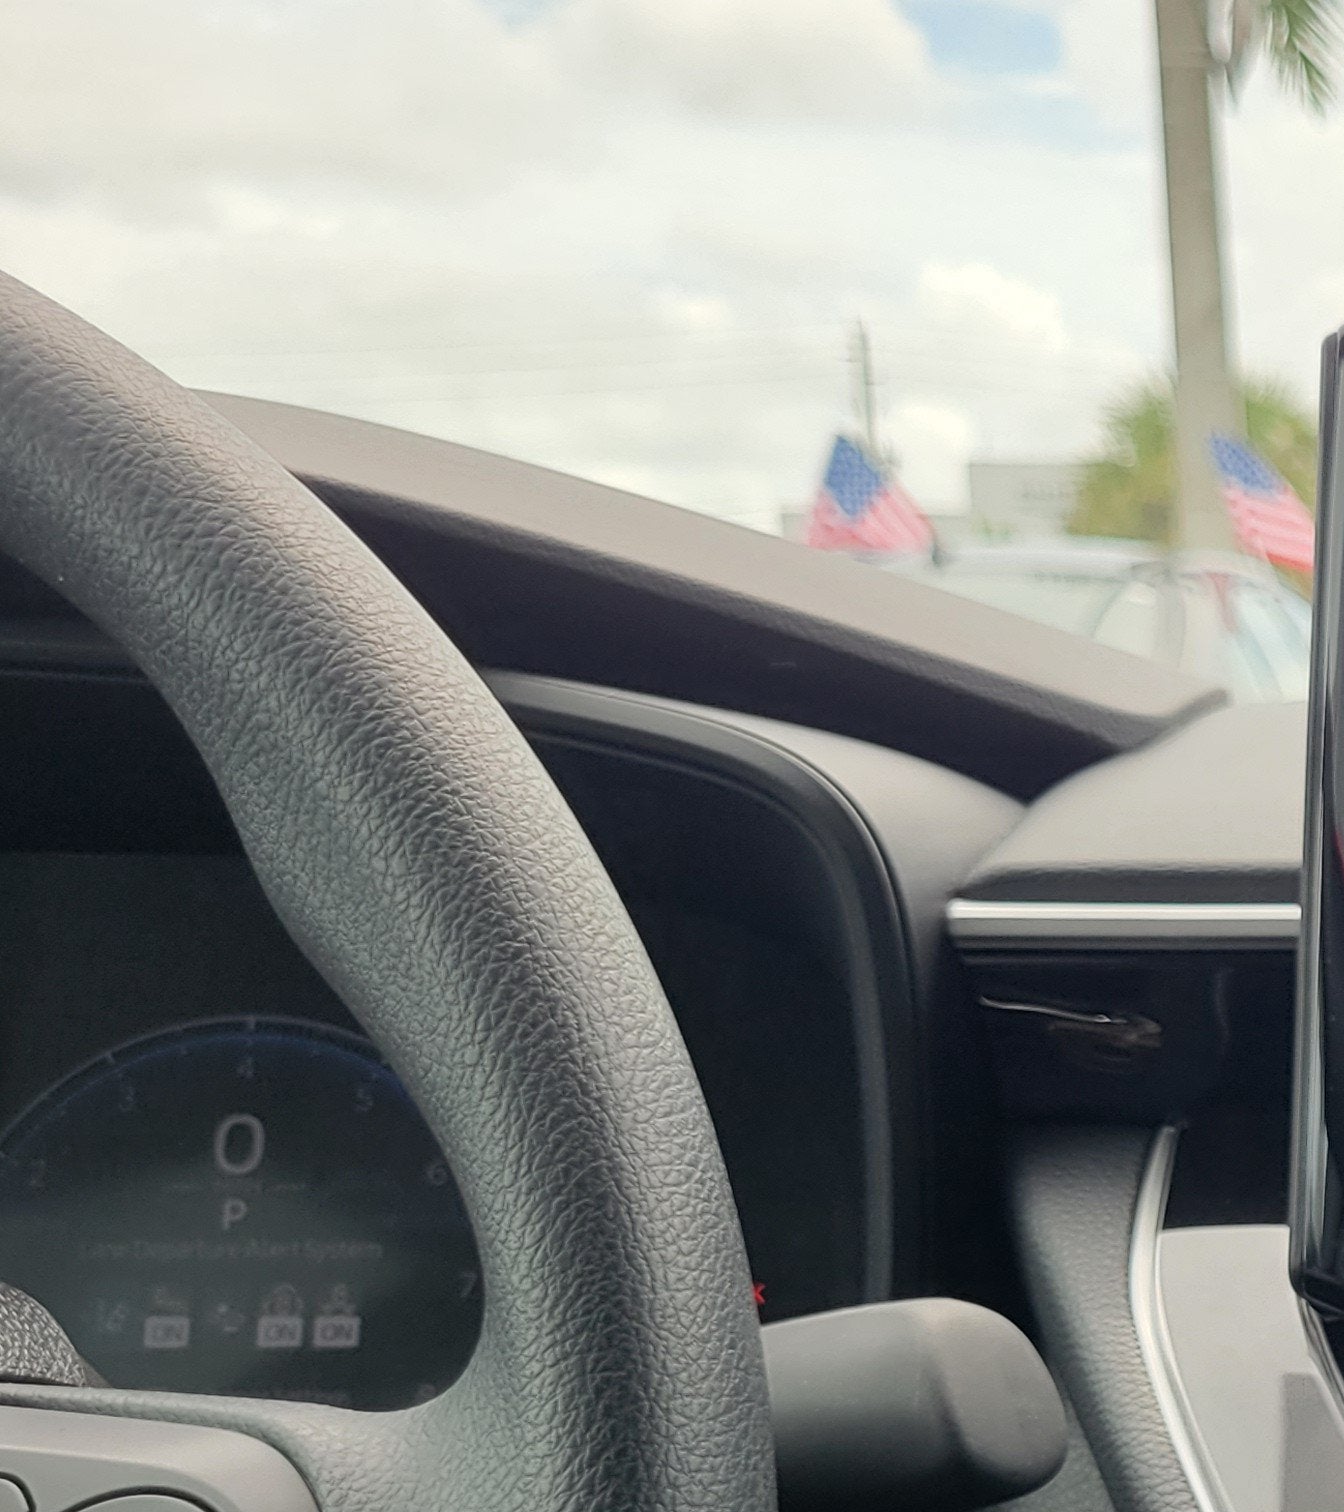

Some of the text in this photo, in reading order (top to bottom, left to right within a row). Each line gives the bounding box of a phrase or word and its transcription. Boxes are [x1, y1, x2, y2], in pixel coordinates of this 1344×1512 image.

[213, 1113, 265, 1175] 0
[426, 1162, 448, 1186] 6
[222, 1198, 248, 1231] P
